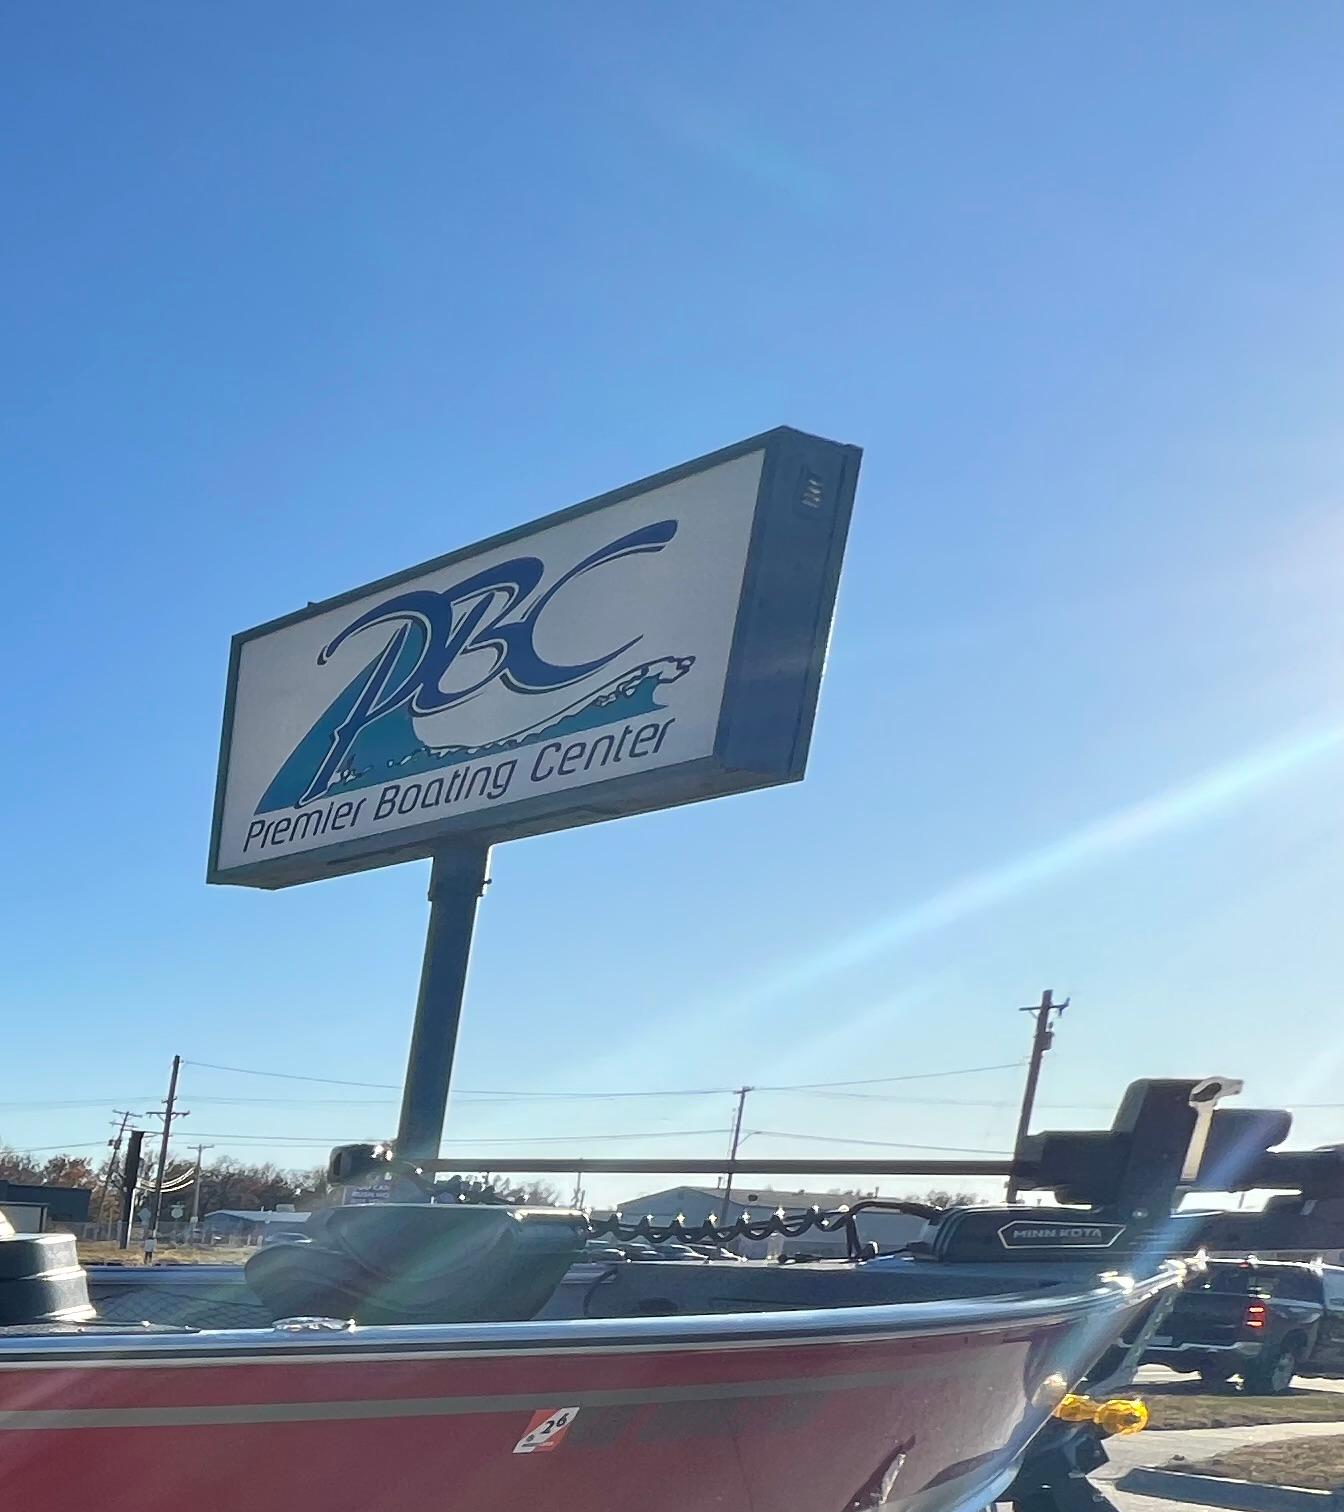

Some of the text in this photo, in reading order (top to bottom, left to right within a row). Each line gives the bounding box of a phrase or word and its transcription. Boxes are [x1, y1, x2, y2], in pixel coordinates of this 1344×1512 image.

[294, 518, 679, 808] PBC
[242, 716, 677, 853] Premier Boating Center
[1013, 1228, 1102, 1238] MINN KOTA
[540, 1412, 570, 1435] 26
